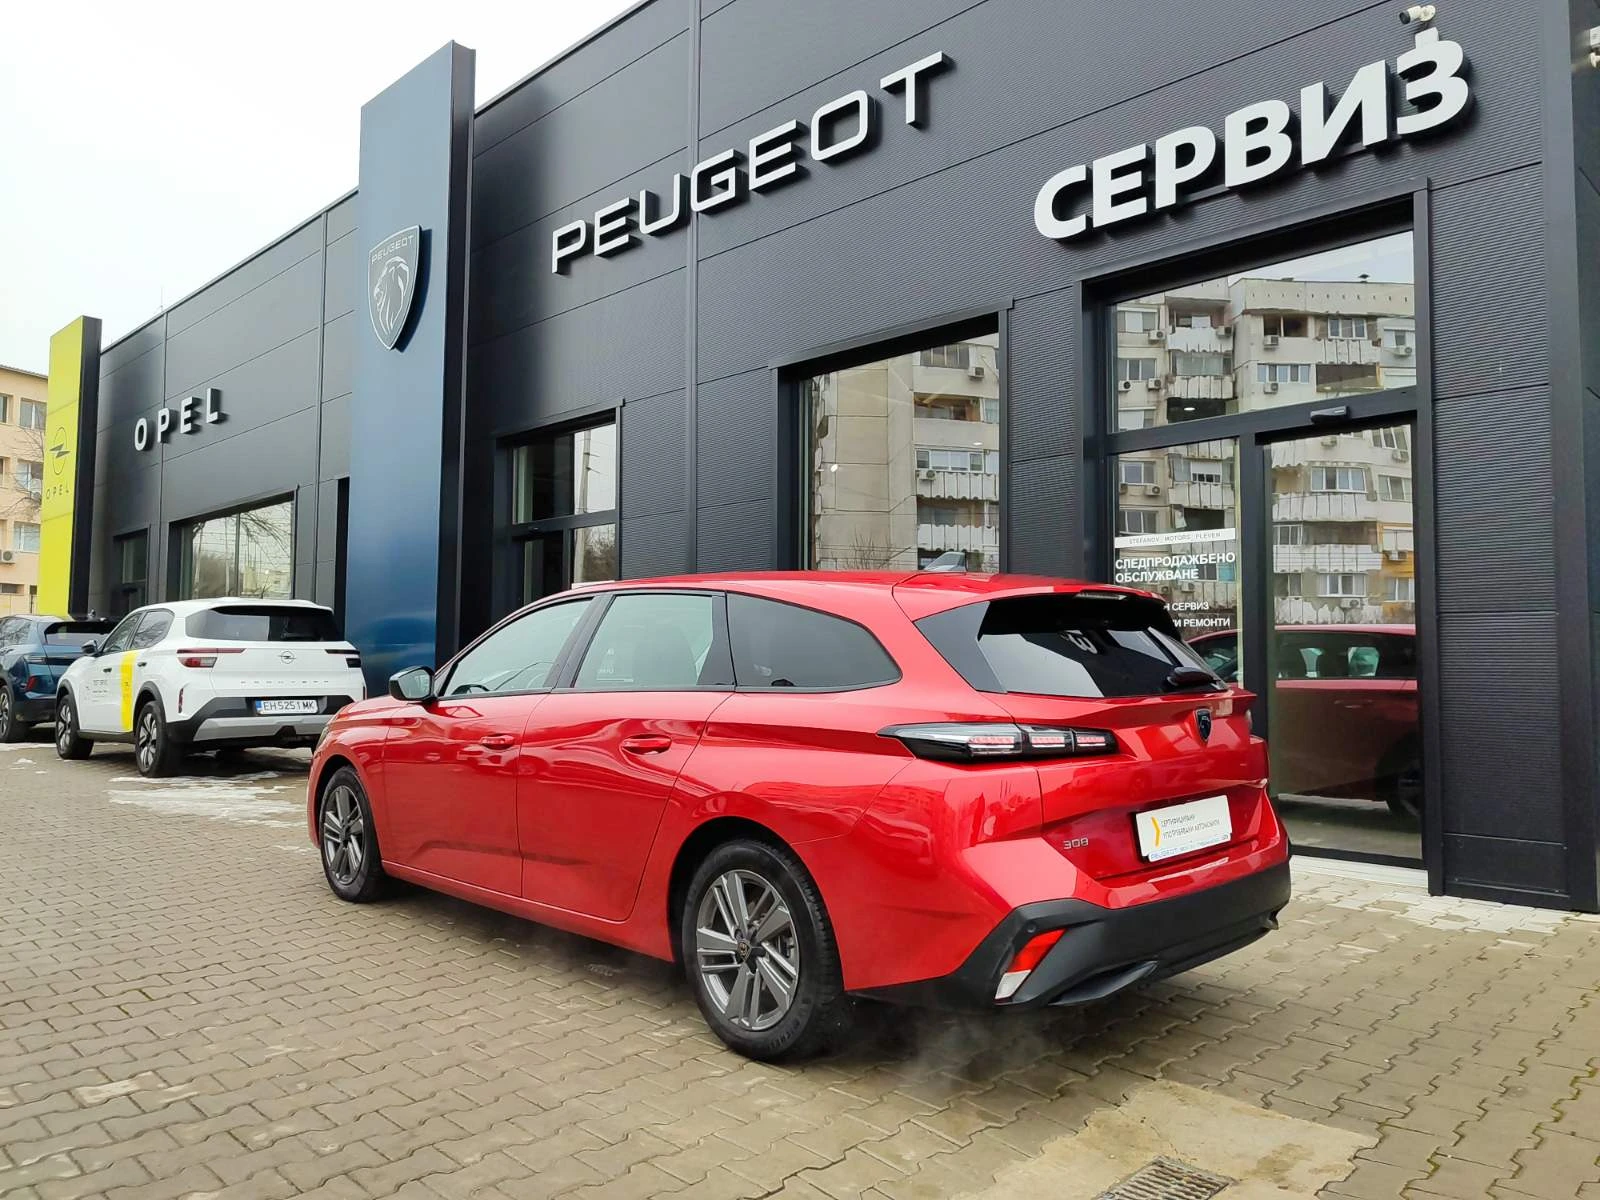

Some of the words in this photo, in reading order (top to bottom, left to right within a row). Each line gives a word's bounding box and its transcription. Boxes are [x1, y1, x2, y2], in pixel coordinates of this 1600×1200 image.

[1034, 38, 1470, 239] СЕРВИЗ
[551, 50, 946, 274] PEUGEOT
[371, 235, 414, 265] PEUGEOT
[134, 387, 219, 451] OPEL
[46, 482, 70, 500] OPEL
[1115, 552, 1236, 570] СЛЕДПРОДАЖБЕНО
[1115, 568, 1200, 583] ОБСЛУЖВАНЕ
[1171, 601, 1210, 611] СЕРВИЗ
[1183, 617, 1231, 628] РЕМОНТИ
[1063, 837, 1089, 850] 308
